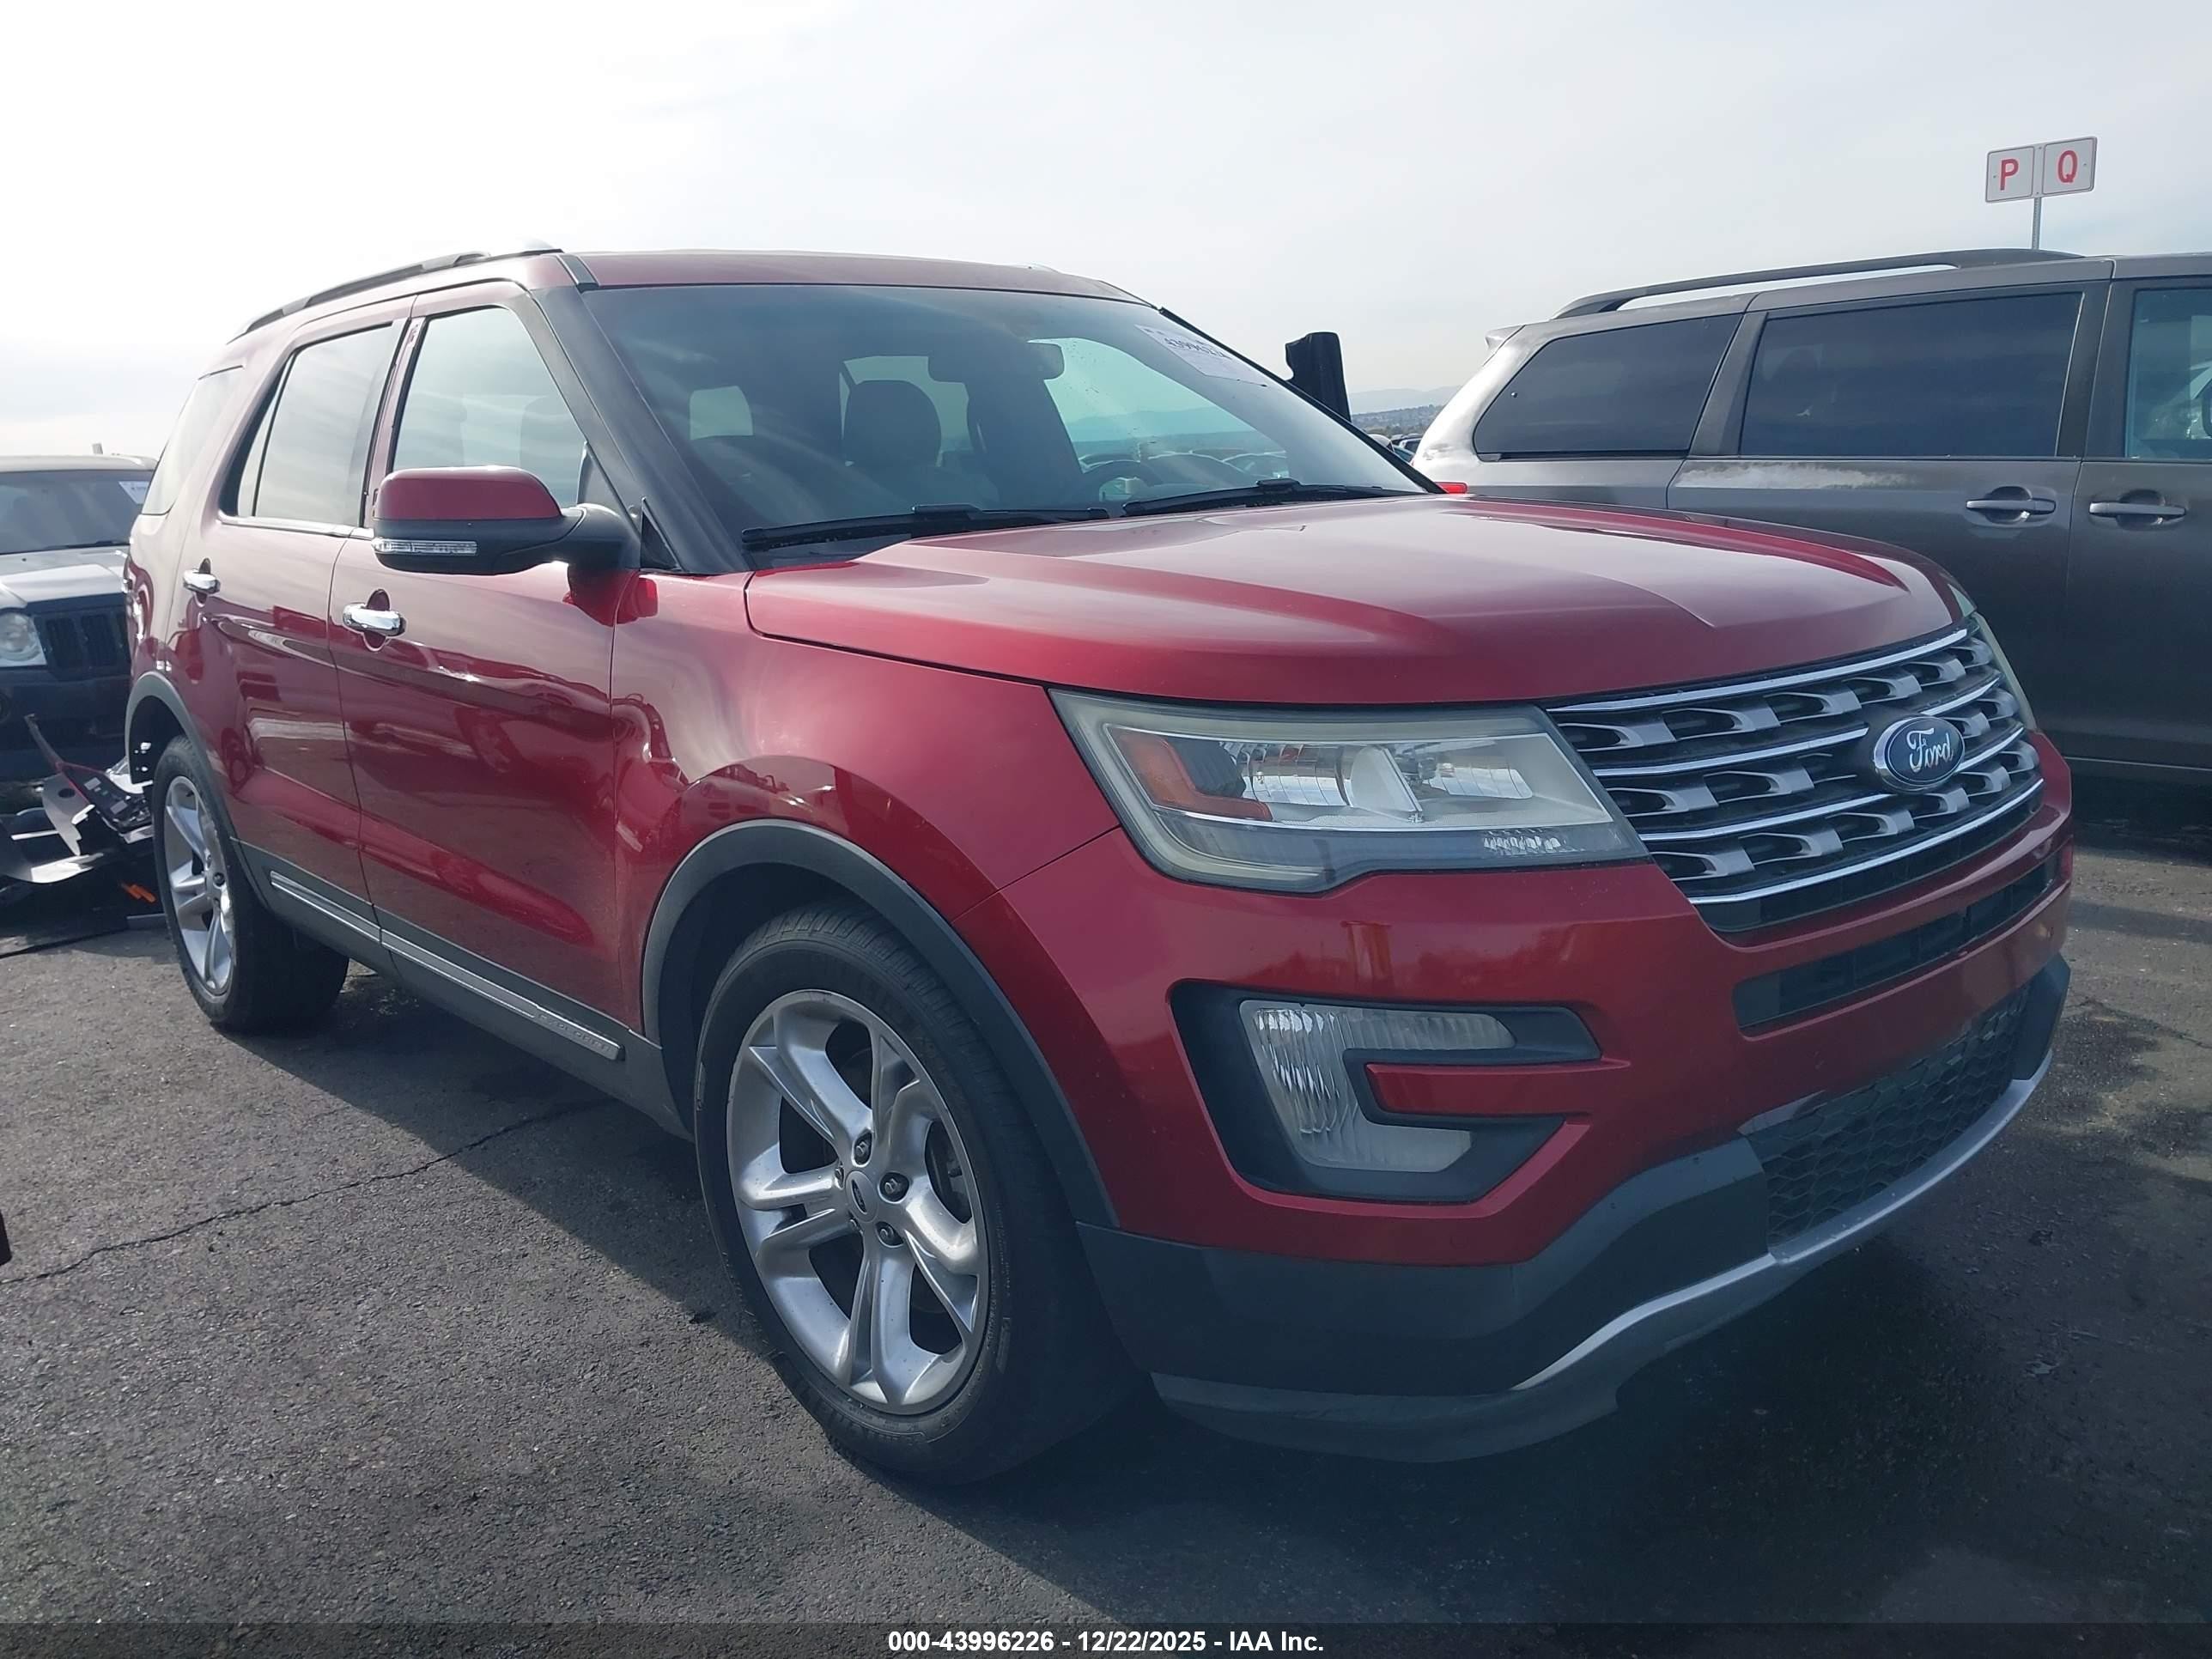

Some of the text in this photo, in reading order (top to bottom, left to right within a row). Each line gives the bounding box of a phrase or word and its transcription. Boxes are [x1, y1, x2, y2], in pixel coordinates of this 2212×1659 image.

[1999, 149, 2078, 191] P Q
[1906, 727, 1954, 773] Ford
